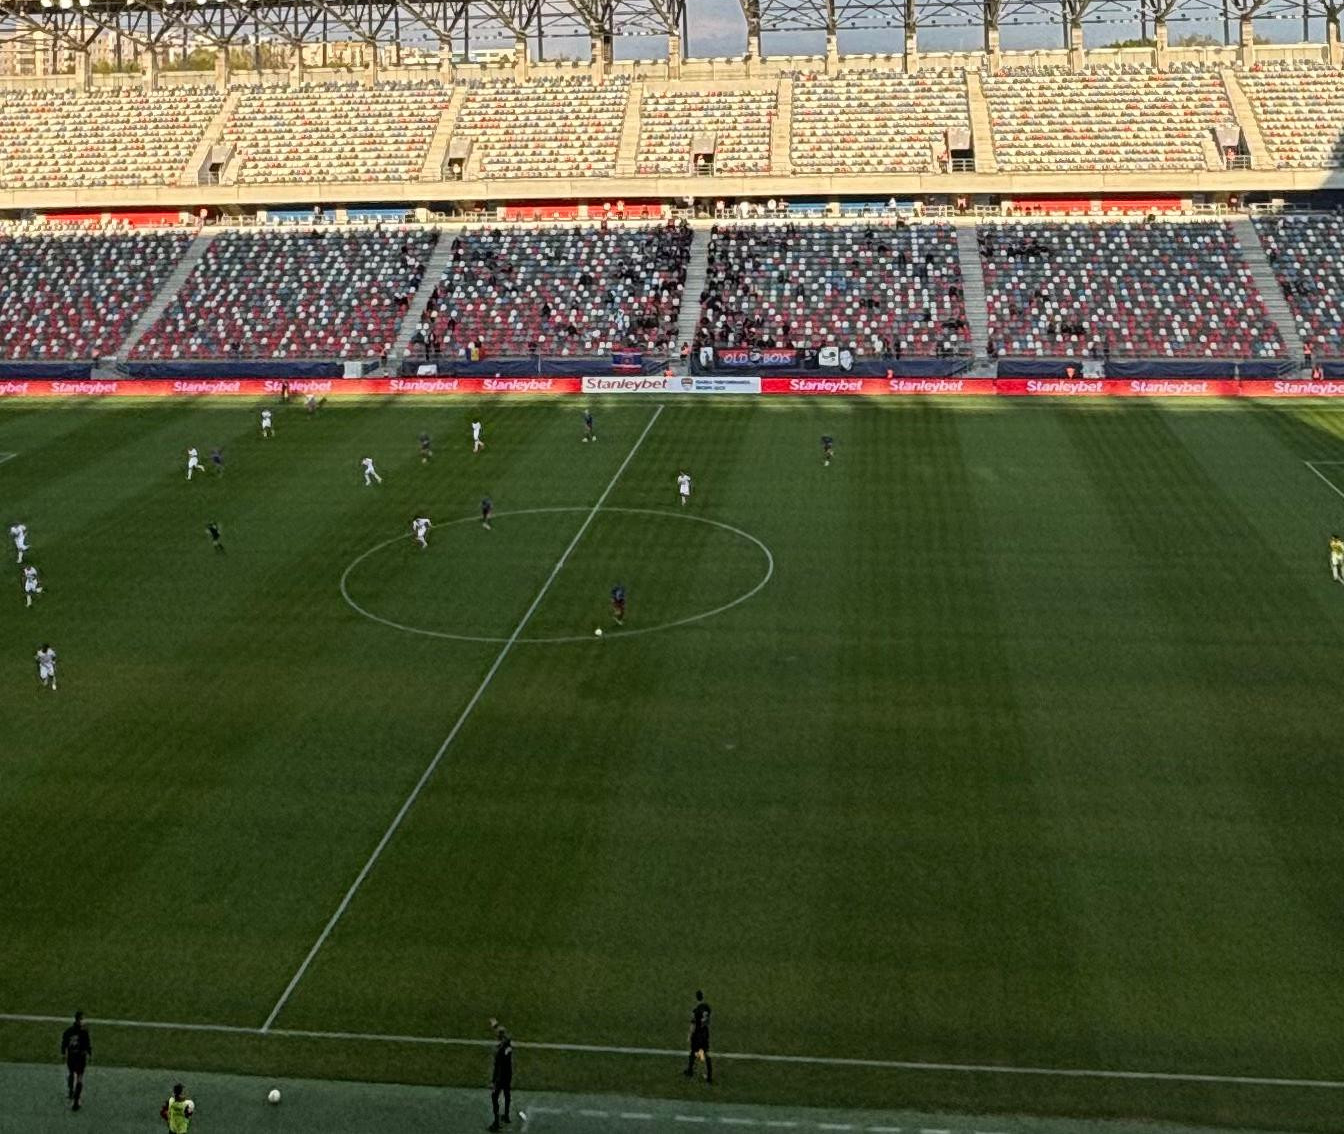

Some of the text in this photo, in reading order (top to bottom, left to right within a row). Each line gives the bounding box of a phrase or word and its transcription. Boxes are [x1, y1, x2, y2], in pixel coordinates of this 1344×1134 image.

[723, 352, 792, 364] OLD BOYS
[51, 381, 117, 394] Stanleybet
[172, 380, 240, 393] Stanleybet
[390, 379, 458, 391] Stanleybet
[483, 379, 552, 391] Stanleybet
[586, 377, 667, 392] Stanleybet
[790, 379, 863, 392] Stanleybet
[889, 379, 964, 393] Stanleybet
[1026, 379, 1103, 393] Stanleybet
[1130, 380, 1207, 394] Stanleybet
